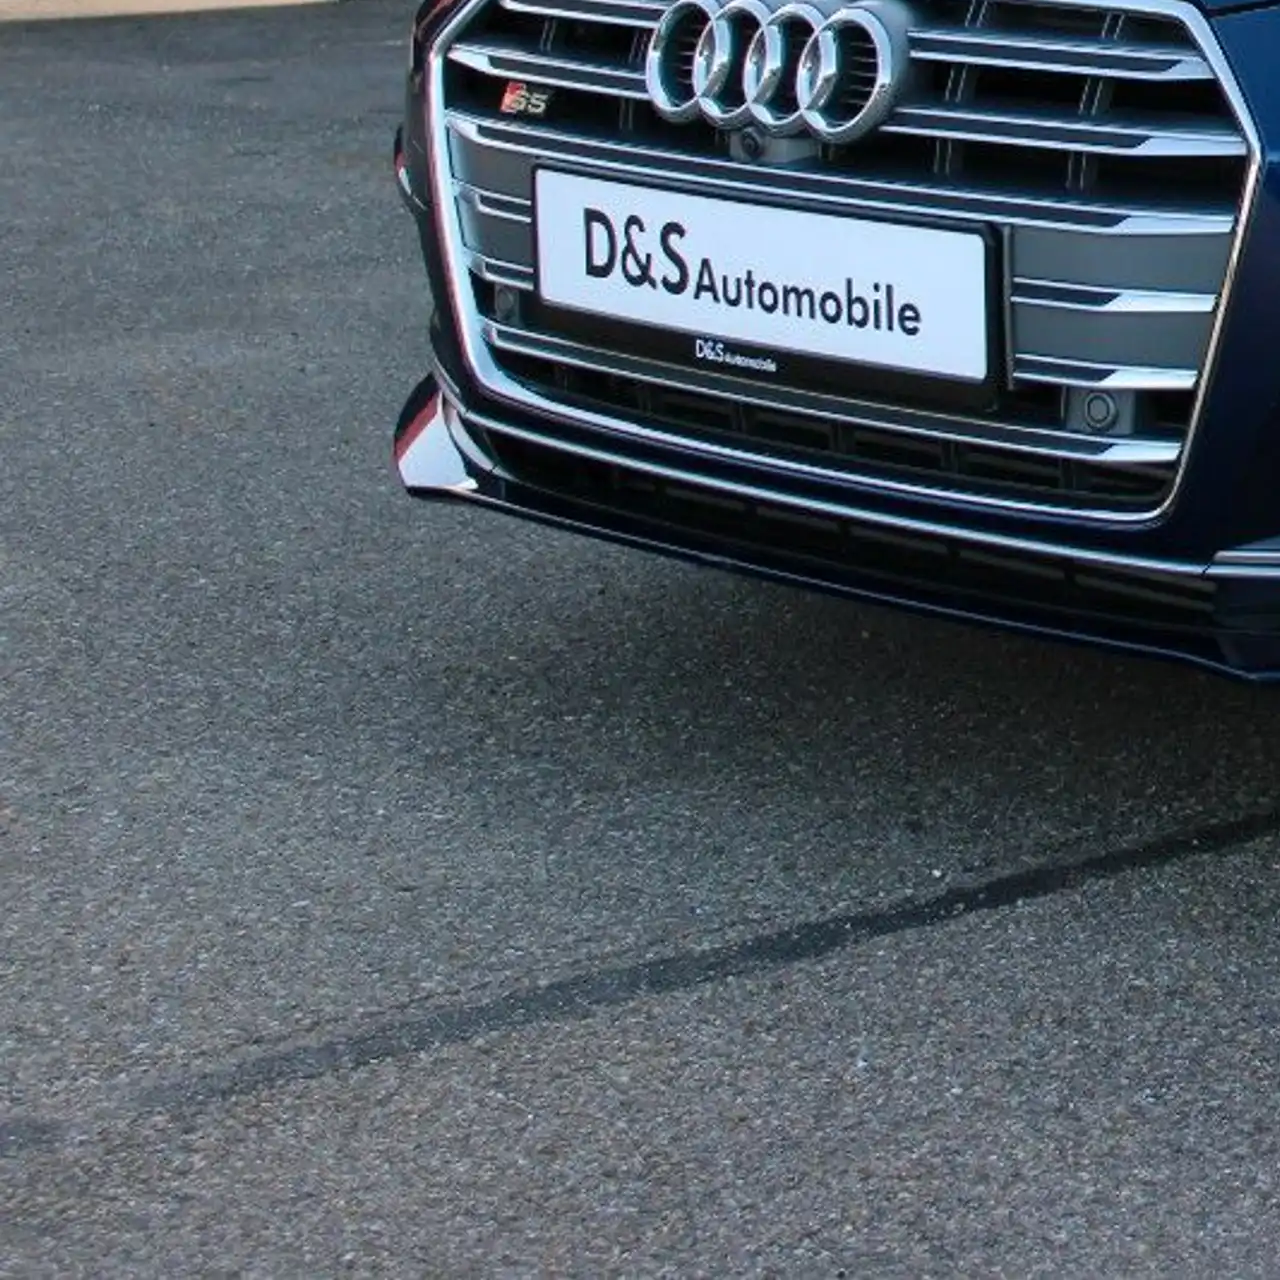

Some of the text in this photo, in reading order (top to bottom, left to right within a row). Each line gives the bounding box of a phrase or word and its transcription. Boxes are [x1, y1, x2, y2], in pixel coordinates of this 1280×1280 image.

[503, 81, 548, 114] S5
[583, 207, 921, 336] D&S Automobile
[695, 338, 724, 361] D&S
